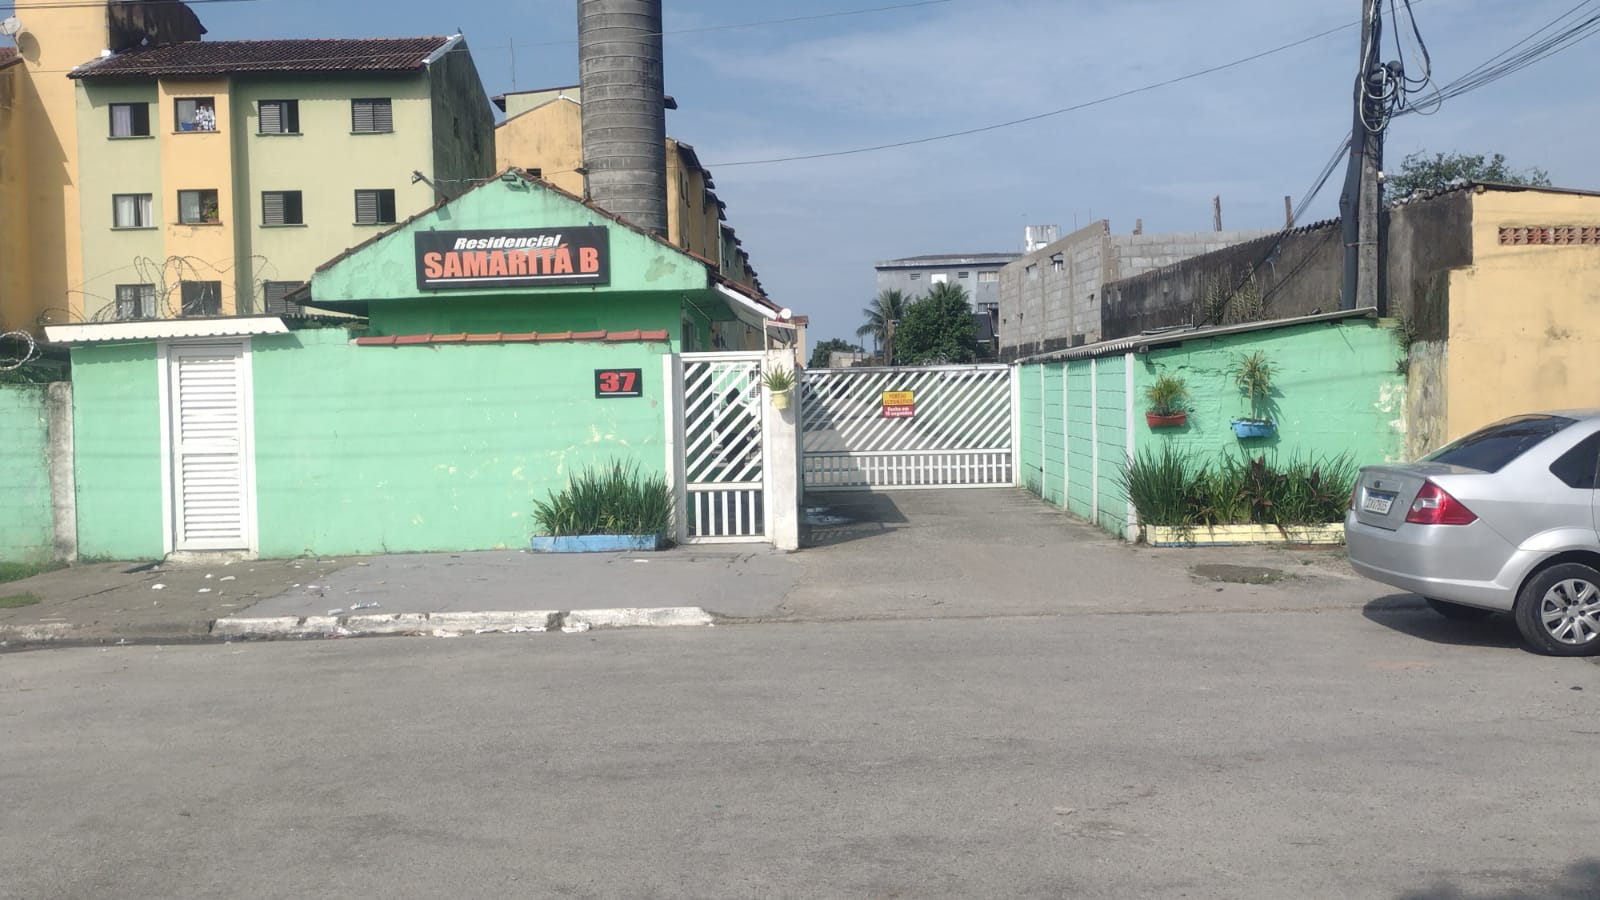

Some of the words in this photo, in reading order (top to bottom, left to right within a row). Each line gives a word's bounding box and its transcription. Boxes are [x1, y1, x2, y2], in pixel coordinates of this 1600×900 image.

[453, 234, 562, 250] Residencial
[424, 243, 574, 278] SAMARITÁ
[579, 247, 599, 273] B
[599, 371, 636, 392] 37
